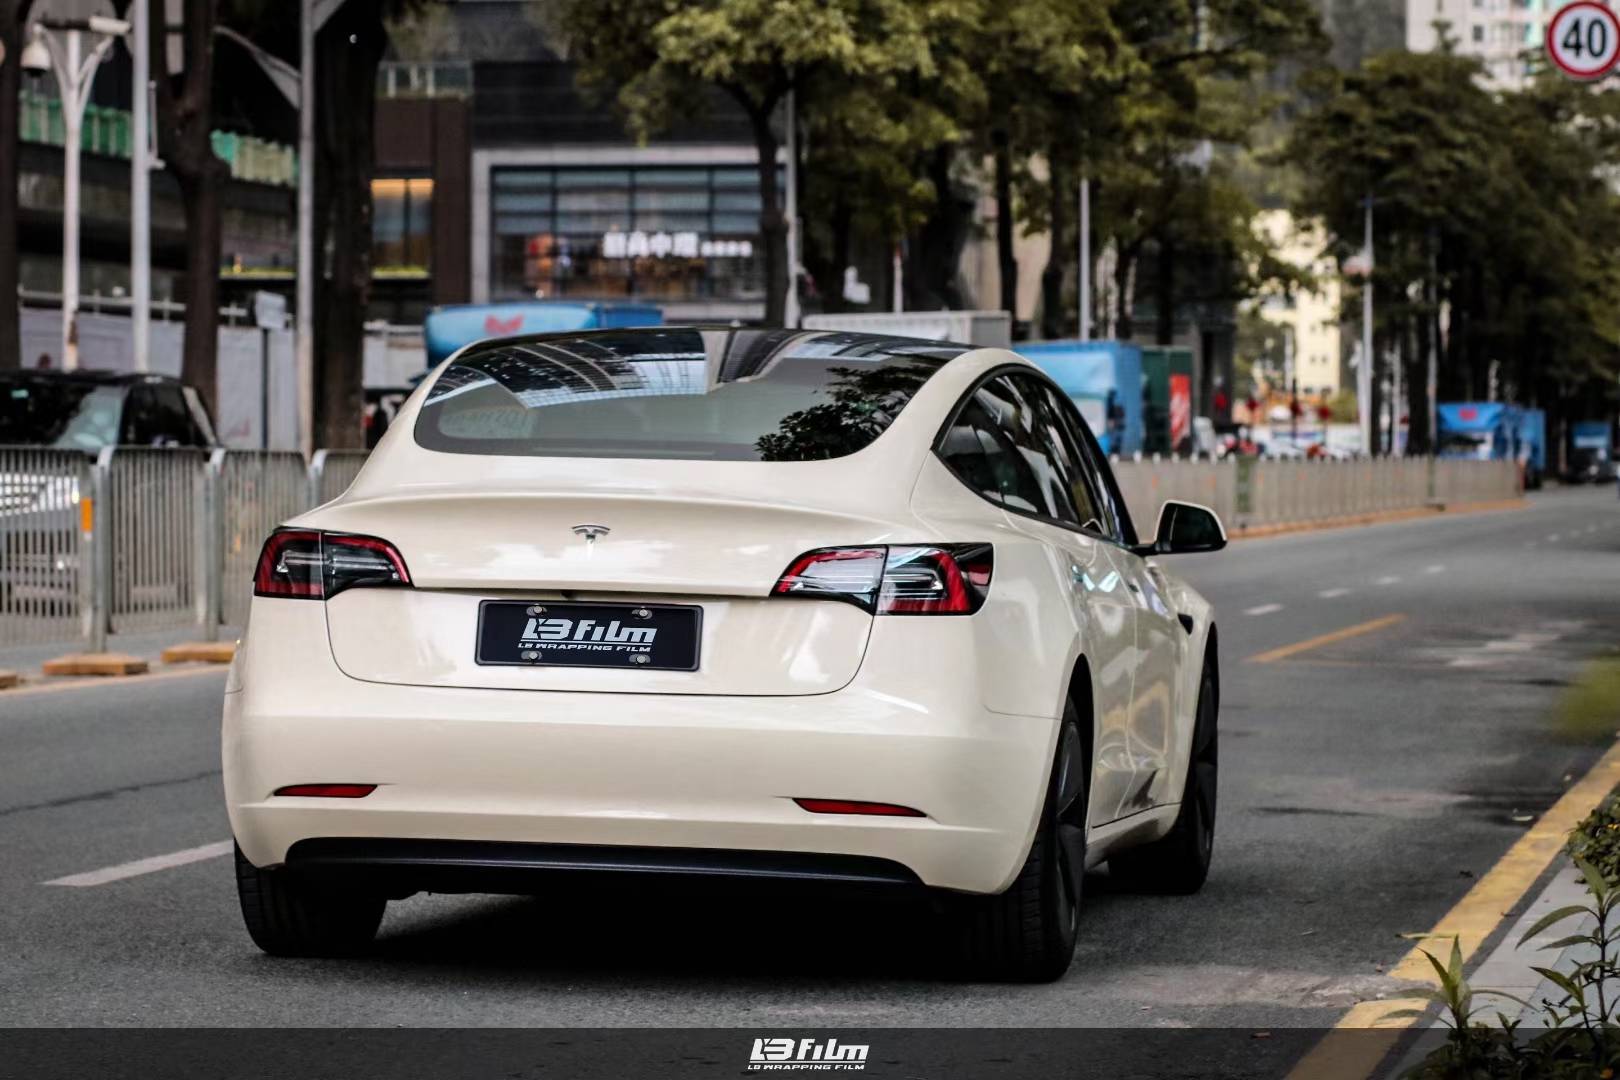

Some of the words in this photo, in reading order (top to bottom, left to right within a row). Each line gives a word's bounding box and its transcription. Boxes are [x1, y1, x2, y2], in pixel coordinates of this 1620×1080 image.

[1563, 18, 1607, 58] 40
[535, 643, 613, 651] WRAPPING
[616, 645, 652, 653] FILM
